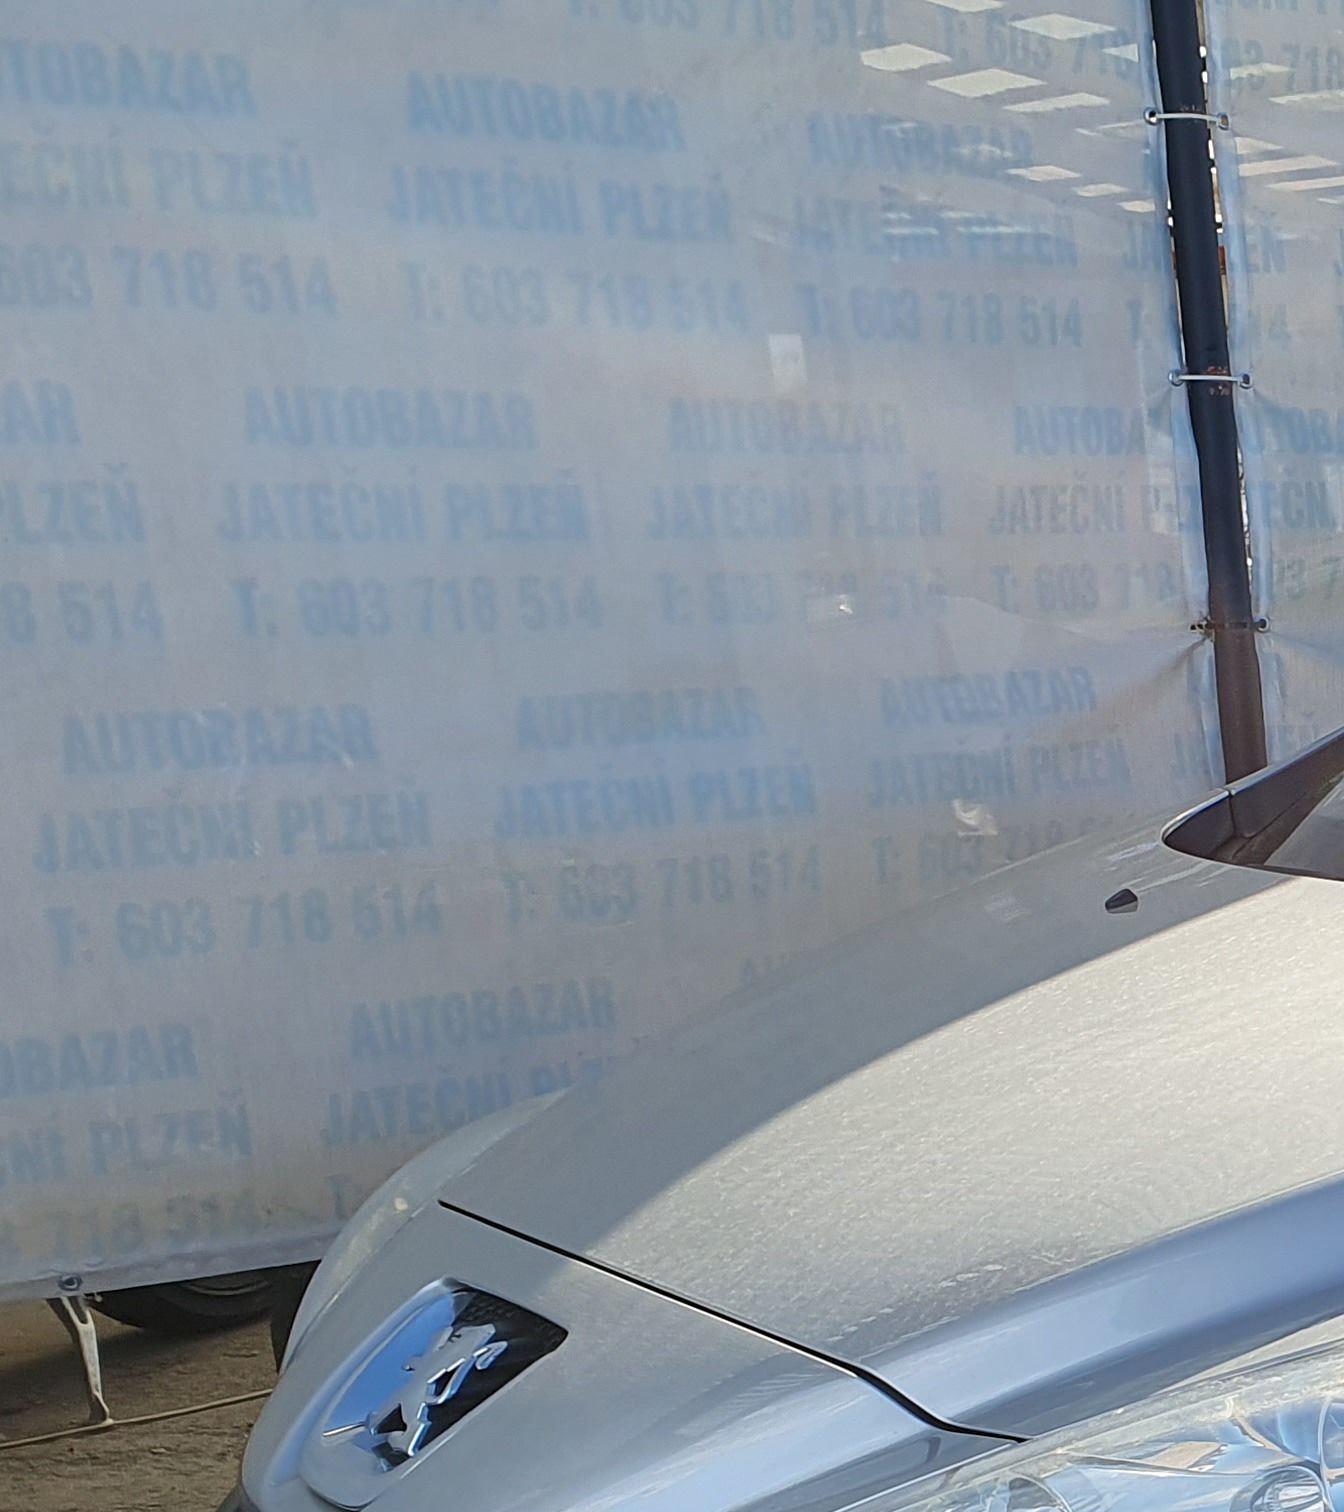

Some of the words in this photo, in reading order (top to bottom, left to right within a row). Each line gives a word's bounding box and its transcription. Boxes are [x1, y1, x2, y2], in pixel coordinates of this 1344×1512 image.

[408, 70, 687, 153] AUTOBAZAR
[385, 155, 582, 237] JATEČNÍ
[599, 169, 736, 245] PLZEŇ
[111, 245, 217, 312] 718
[237, 251, 339, 320] 514
[937, 290, 1003, 346] 718
[1020, 295, 1083, 349] 514
[244, 385, 541, 450] AUTOBAZAR
[667, 396, 910, 455] AUTOBAZAR
[217, 464, 428, 544] JATEČNÍ
[444, 467, 590, 544] PLZEŇ
[644, 468, 815, 541] JATEČNÍ
[827, 469, 945, 539] PLZEŇ
[988, 470, 1126, 537] JATEČNÍ
[58, 580, 166, 645] 514
[296, 575, 393, 638] 603
[408, 575, 498, 641] 718
[514, 573, 606, 633] 514
[1034, 562, 1101, 617] 603
[517, 685, 767, 752] AUTOBAZAR
[881, 666, 1099, 729] AUTOBAZAR
[62, 703, 380, 776] AUTOBAZAR
[867, 732, 1017, 809] JATEČNÍ
[32, 783, 257, 874] JATEČNÍ
[276, 774, 434, 856] PLZEŇ
[494, 756, 675, 839] JATEČNÍ
[688, 747, 818, 823] PLZEŇ
[115, 896, 218, 961] 603
[235, 885, 334, 949] 718
[352, 878, 446, 942] 514
[558, 860, 639, 922] 603
[656, 852, 734, 909] 718
[748, 844, 823, 903] 514
[350, 976, 618, 1061] AUTOBAZAR
[89, 1086, 253, 1175] PLZEŇ
